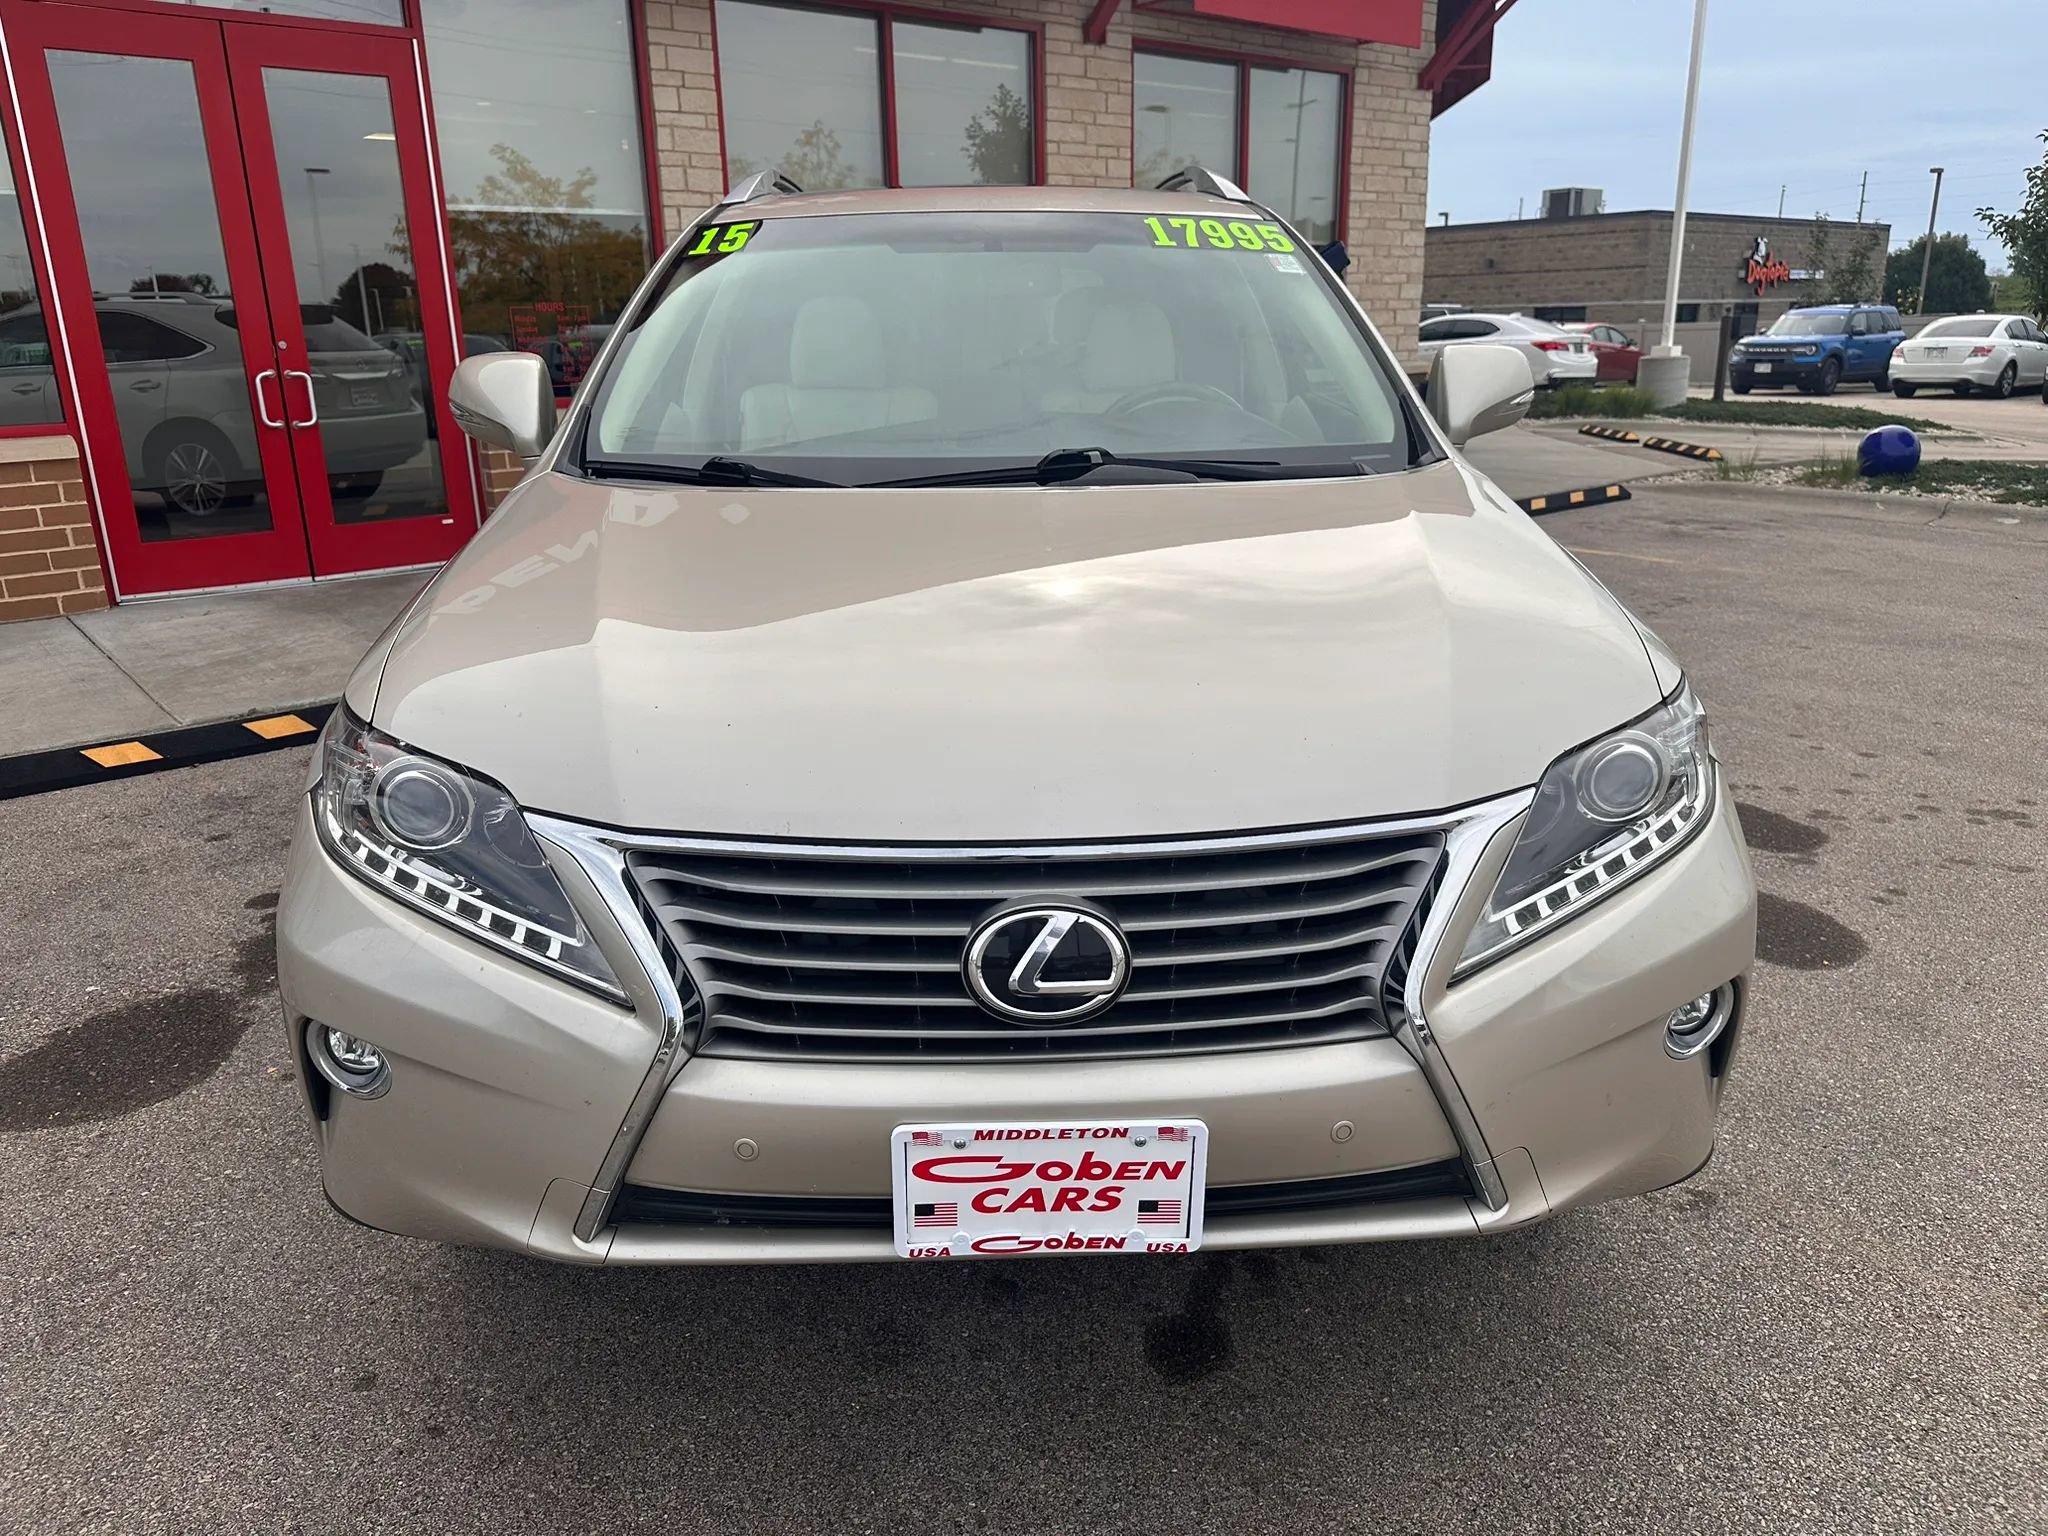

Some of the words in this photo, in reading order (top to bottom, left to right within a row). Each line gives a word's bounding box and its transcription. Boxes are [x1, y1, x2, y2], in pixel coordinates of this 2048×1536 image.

[687, 222, 755, 256] 15
[1144, 217, 1295, 253] 17995
[535, 302, 565, 312] HOURS
[973, 1127, 1130, 1141] MIDDLETON
[971, 1186, 1126, 1214] CARS
[908, 1247, 951, 1258] USA
[1145, 1242, 1188, 1254] USA
